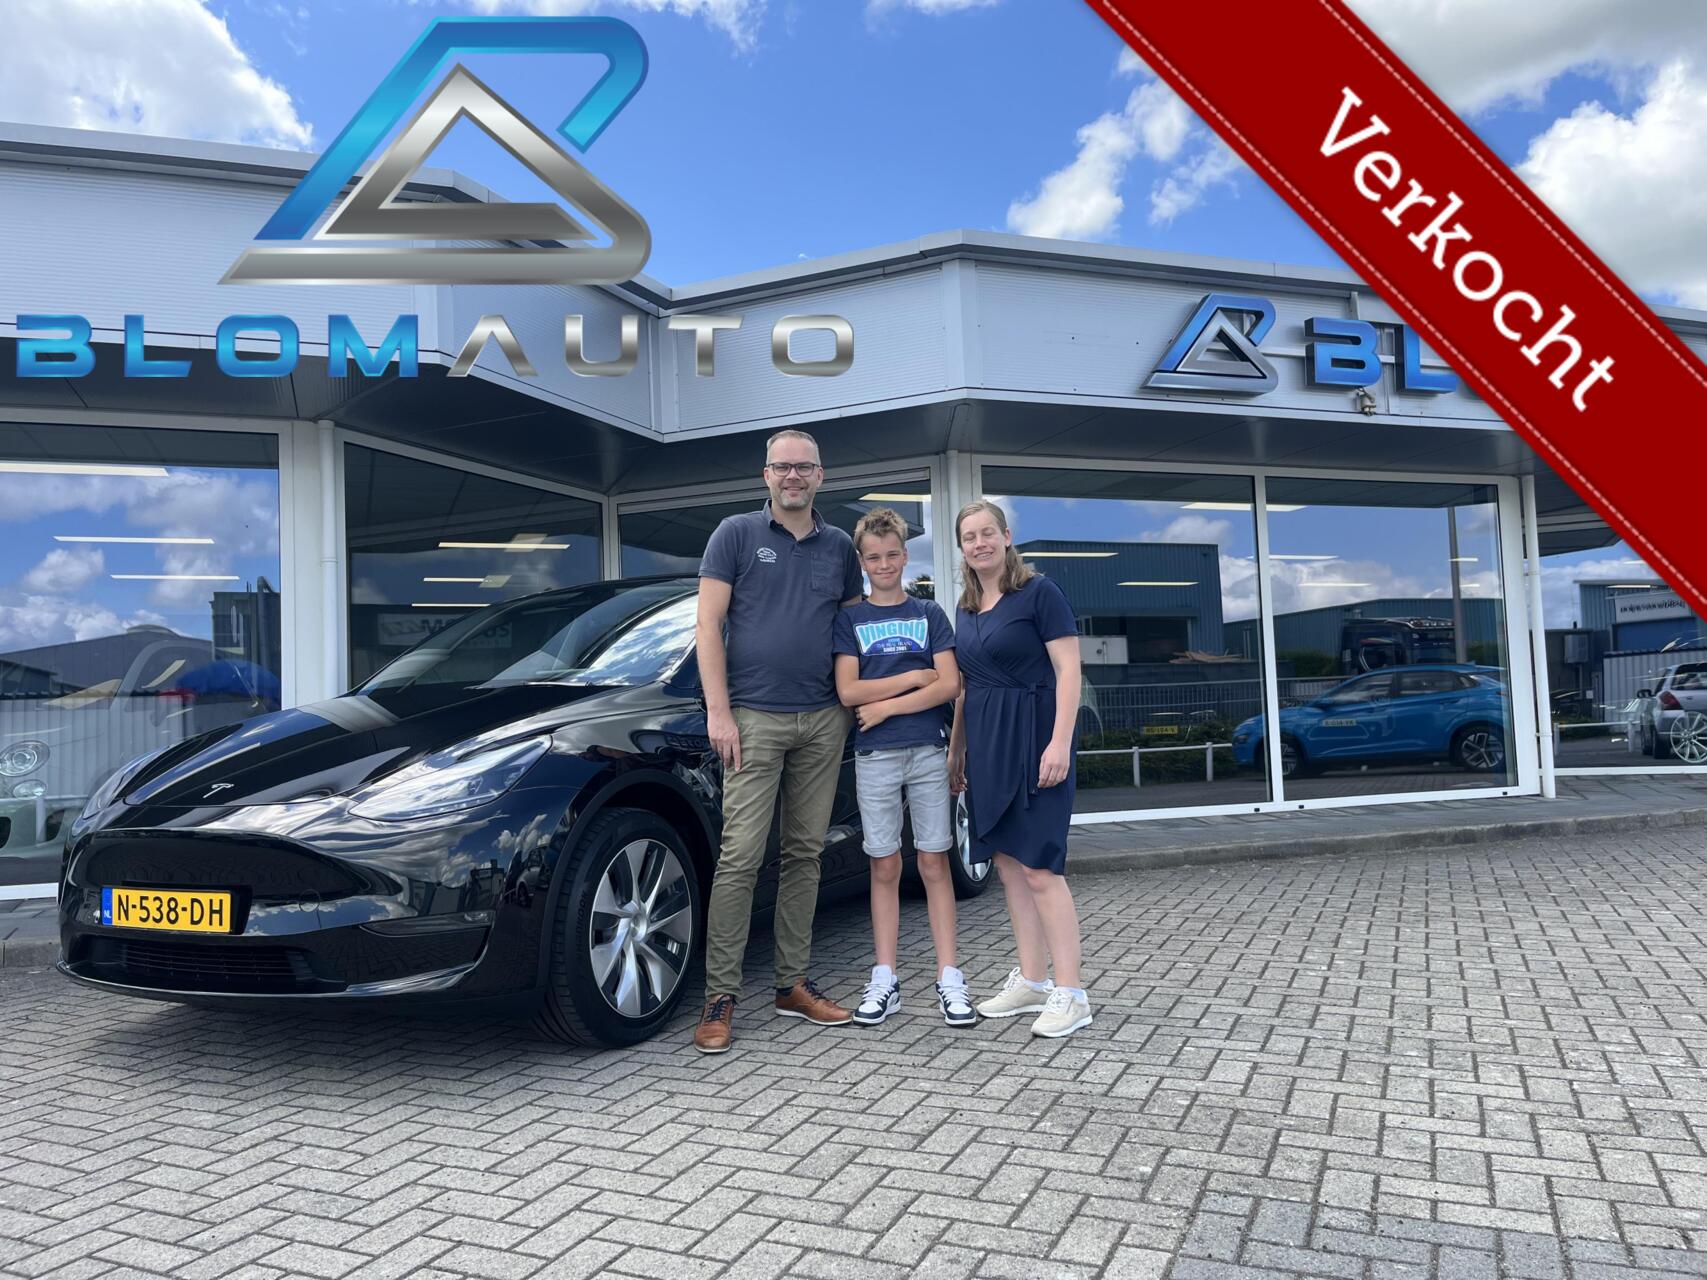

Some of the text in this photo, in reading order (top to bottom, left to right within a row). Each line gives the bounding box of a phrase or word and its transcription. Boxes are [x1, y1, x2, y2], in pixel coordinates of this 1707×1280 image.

[855, 619, 928, 653] VINGINO
[103, 894, 223, 927] NL N-538-DH
